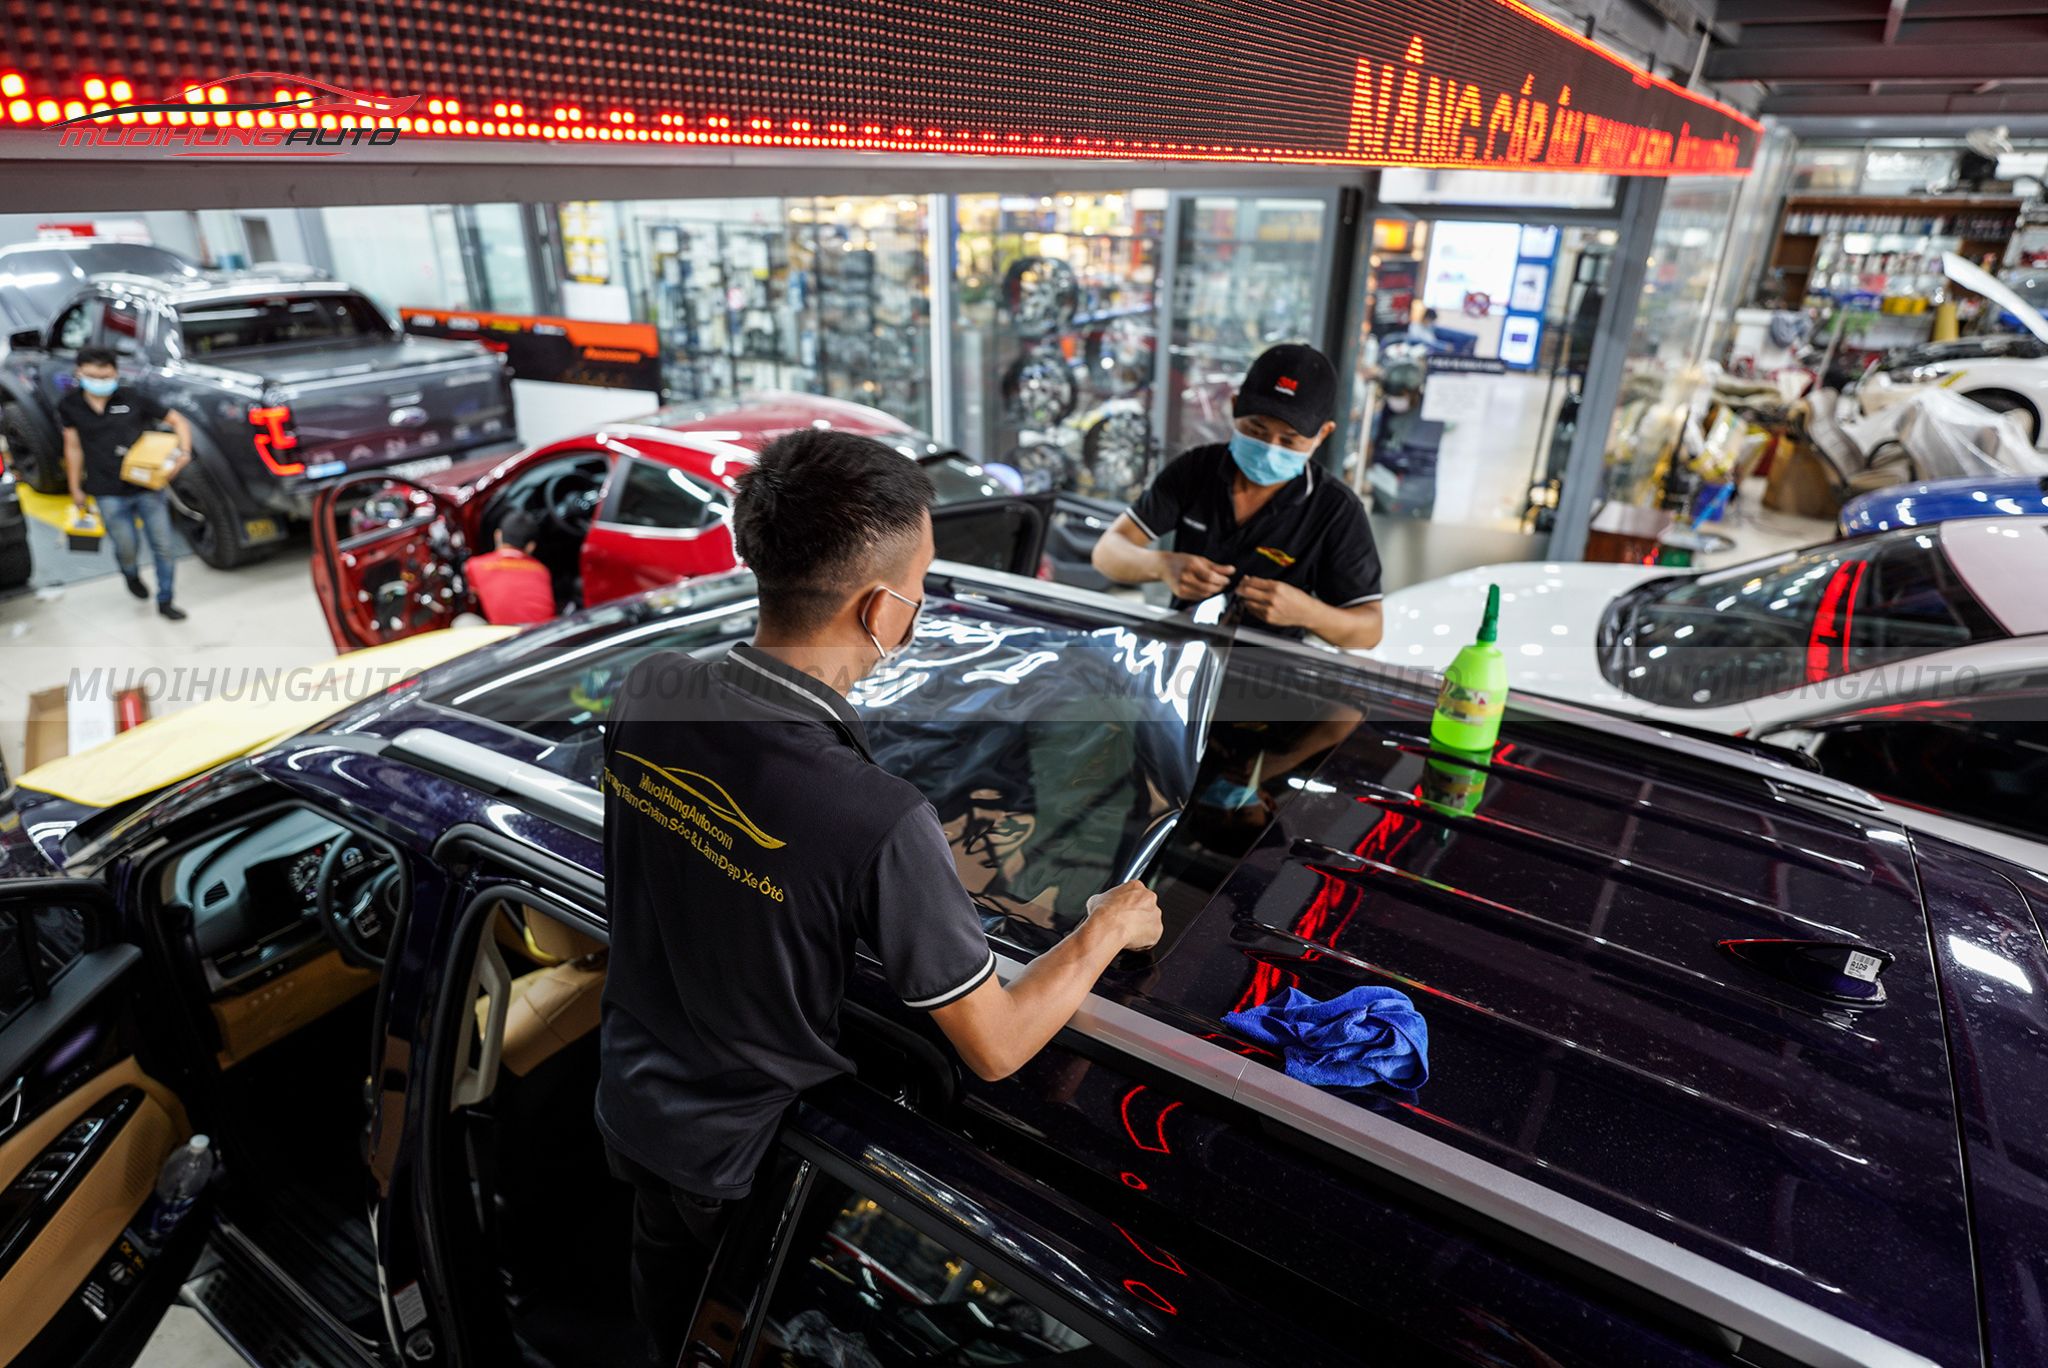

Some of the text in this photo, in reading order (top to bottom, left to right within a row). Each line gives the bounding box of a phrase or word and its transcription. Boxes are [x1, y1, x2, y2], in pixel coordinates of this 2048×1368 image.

[1347, 35, 1483, 161] NÂNG
[638, 772, 733, 850] MuoiHungAuto.com
[667, 818, 690, 839] Sóc
[690, 831, 698, 847] &
[696, 837, 719, 864] Làm
[718, 854, 741, 880] Đẹp
[741, 869, 758, 889] Xe
